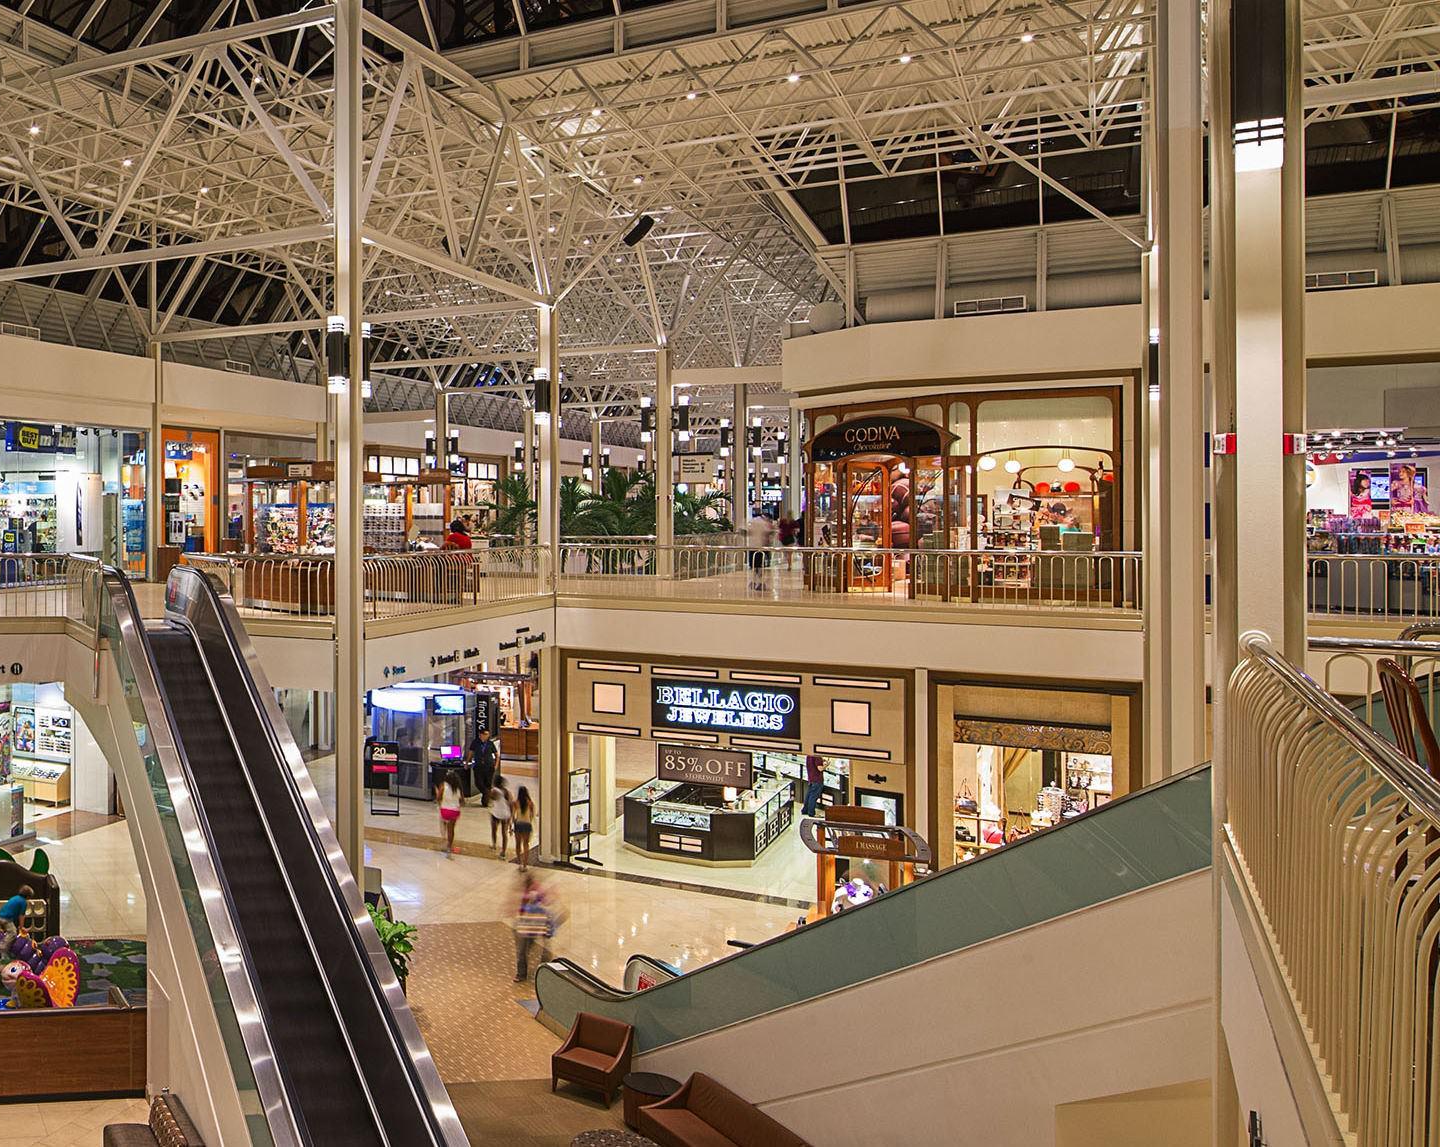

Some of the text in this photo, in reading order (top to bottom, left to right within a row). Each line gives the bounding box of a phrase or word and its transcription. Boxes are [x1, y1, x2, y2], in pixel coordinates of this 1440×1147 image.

[21, 430, 38, 438] BEST
[844, 425, 901, 443] GODIVA
[22, 438, 37, 446] BUY
[853, 442, 892, 451] Chocolatier
[657, 686, 794, 714] BELLAGIO
[478, 700, 488, 719] find
[666, 706, 784, 730] JEWELERS
[373, 747, 386, 756] 20
[664, 755, 747, 777] 85% OFF
[685, 773, 725, 783] STOREWIDE
[860, 842, 888, 852] MASSAGE
